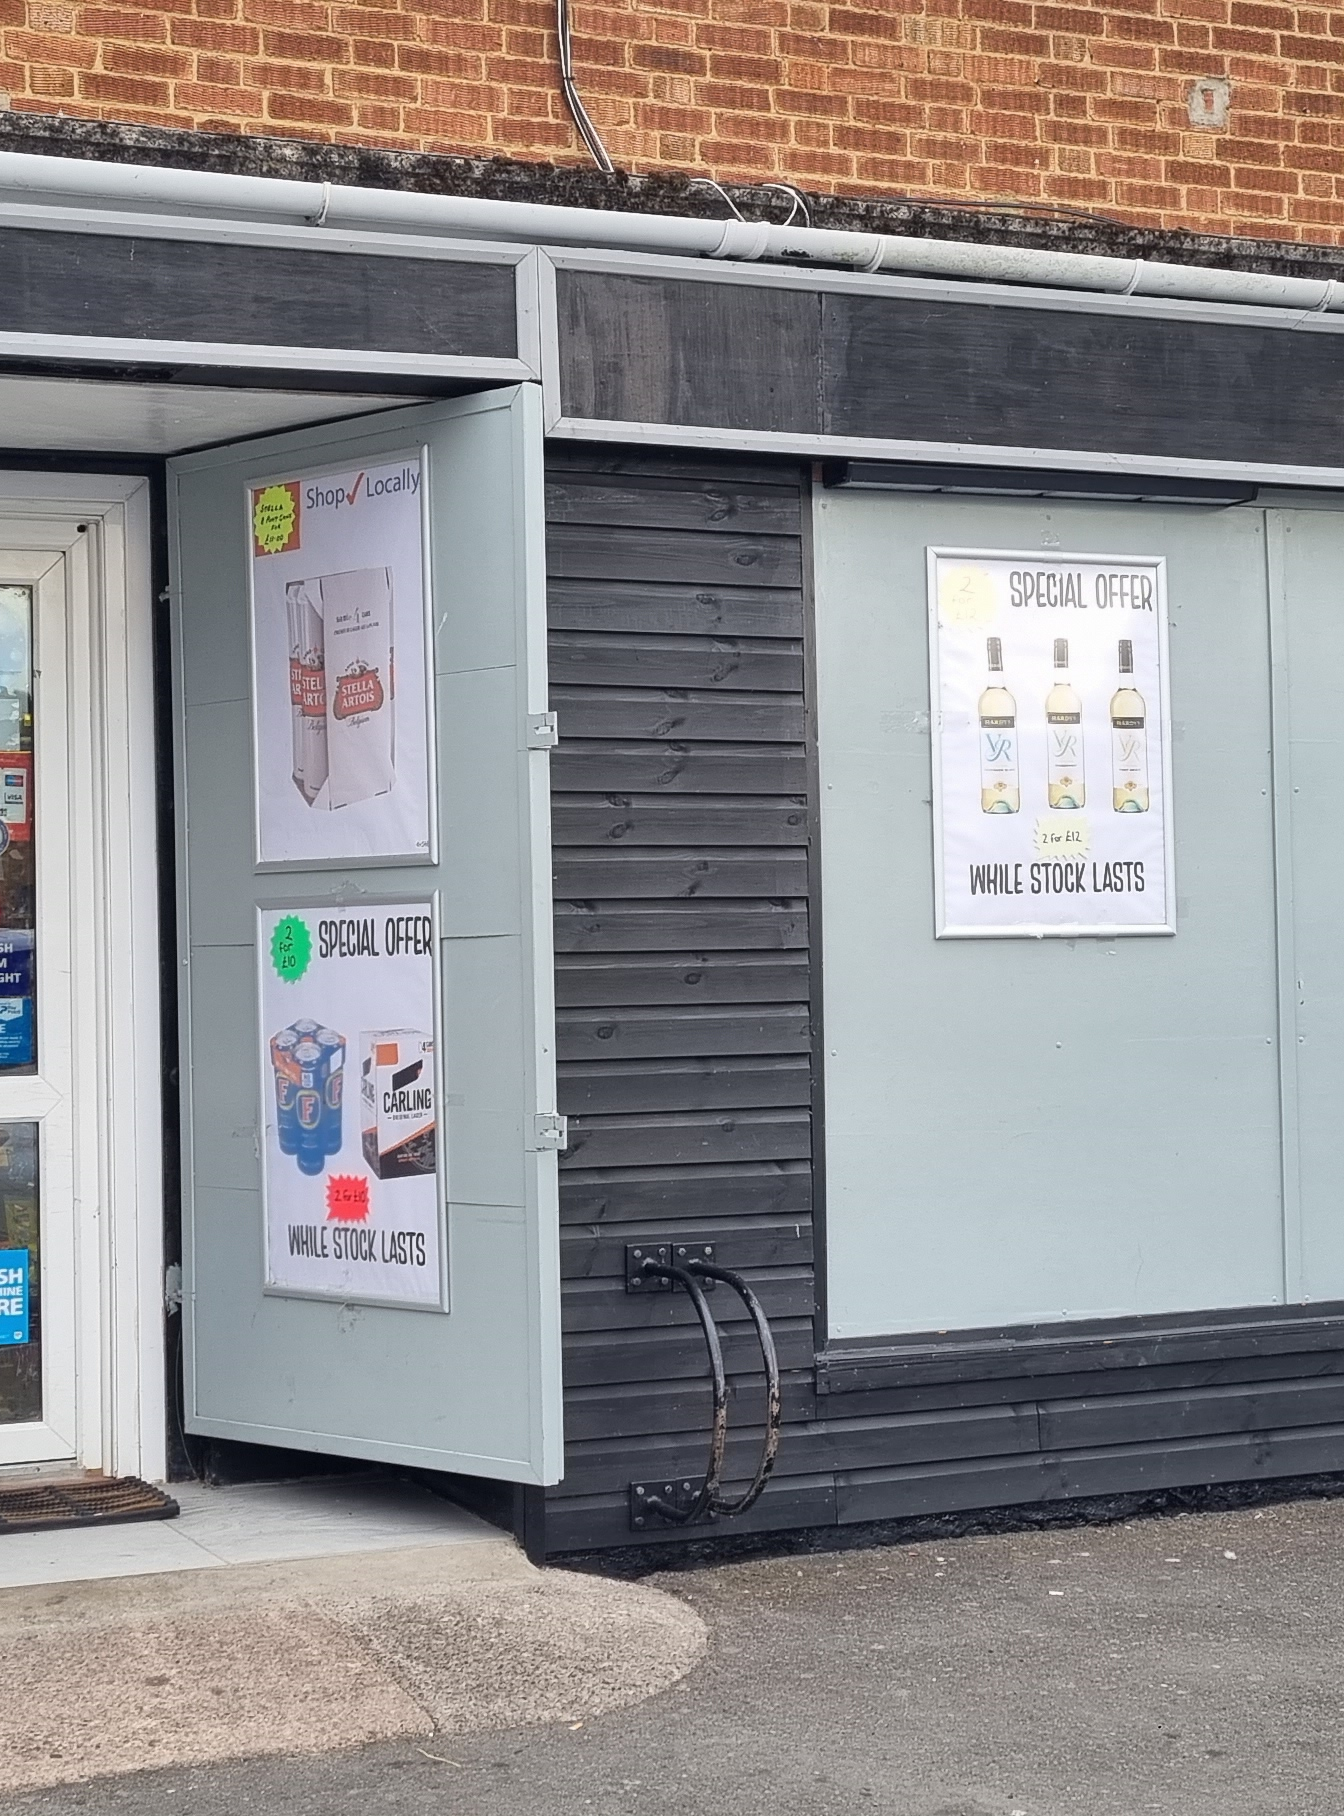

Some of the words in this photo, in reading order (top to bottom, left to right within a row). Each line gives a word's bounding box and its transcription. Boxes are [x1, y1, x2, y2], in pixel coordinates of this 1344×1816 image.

[306, 486, 345, 509] Shop
[366, 468, 421, 497] Locally
[959, 576, 976, 594] 2
[1009, 571, 1088, 609] SPECIAL
[1095, 573, 1153, 612] OFFER
[302, 677, 323, 690] STEL
[342, 680, 374, 696] STELLA
[342, 691, 375, 708] ARTOIS
[1042, 833, 1048, 844] 2
[1065, 830, 1082, 843] £12
[969, 863, 1024, 896] WHILE
[1030, 862, 1086, 894] STOCK
[1093, 861, 1145, 893] LASTS
[285, 926, 293, 940] 2
[319, 918, 379, 958] SPECIAL
[385, 916, 432, 957] OFFER
[282, 955, 296, 969] £10
[301, 1096, 315, 1122] F
[383, 1088, 432, 1113] CARLING
[334, 1190, 342, 1202] 2
[288, 1224, 329, 1258] WHILE
[333, 1227, 377, 1262] STOCK
[382, 1230, 426, 1267] LASTS
